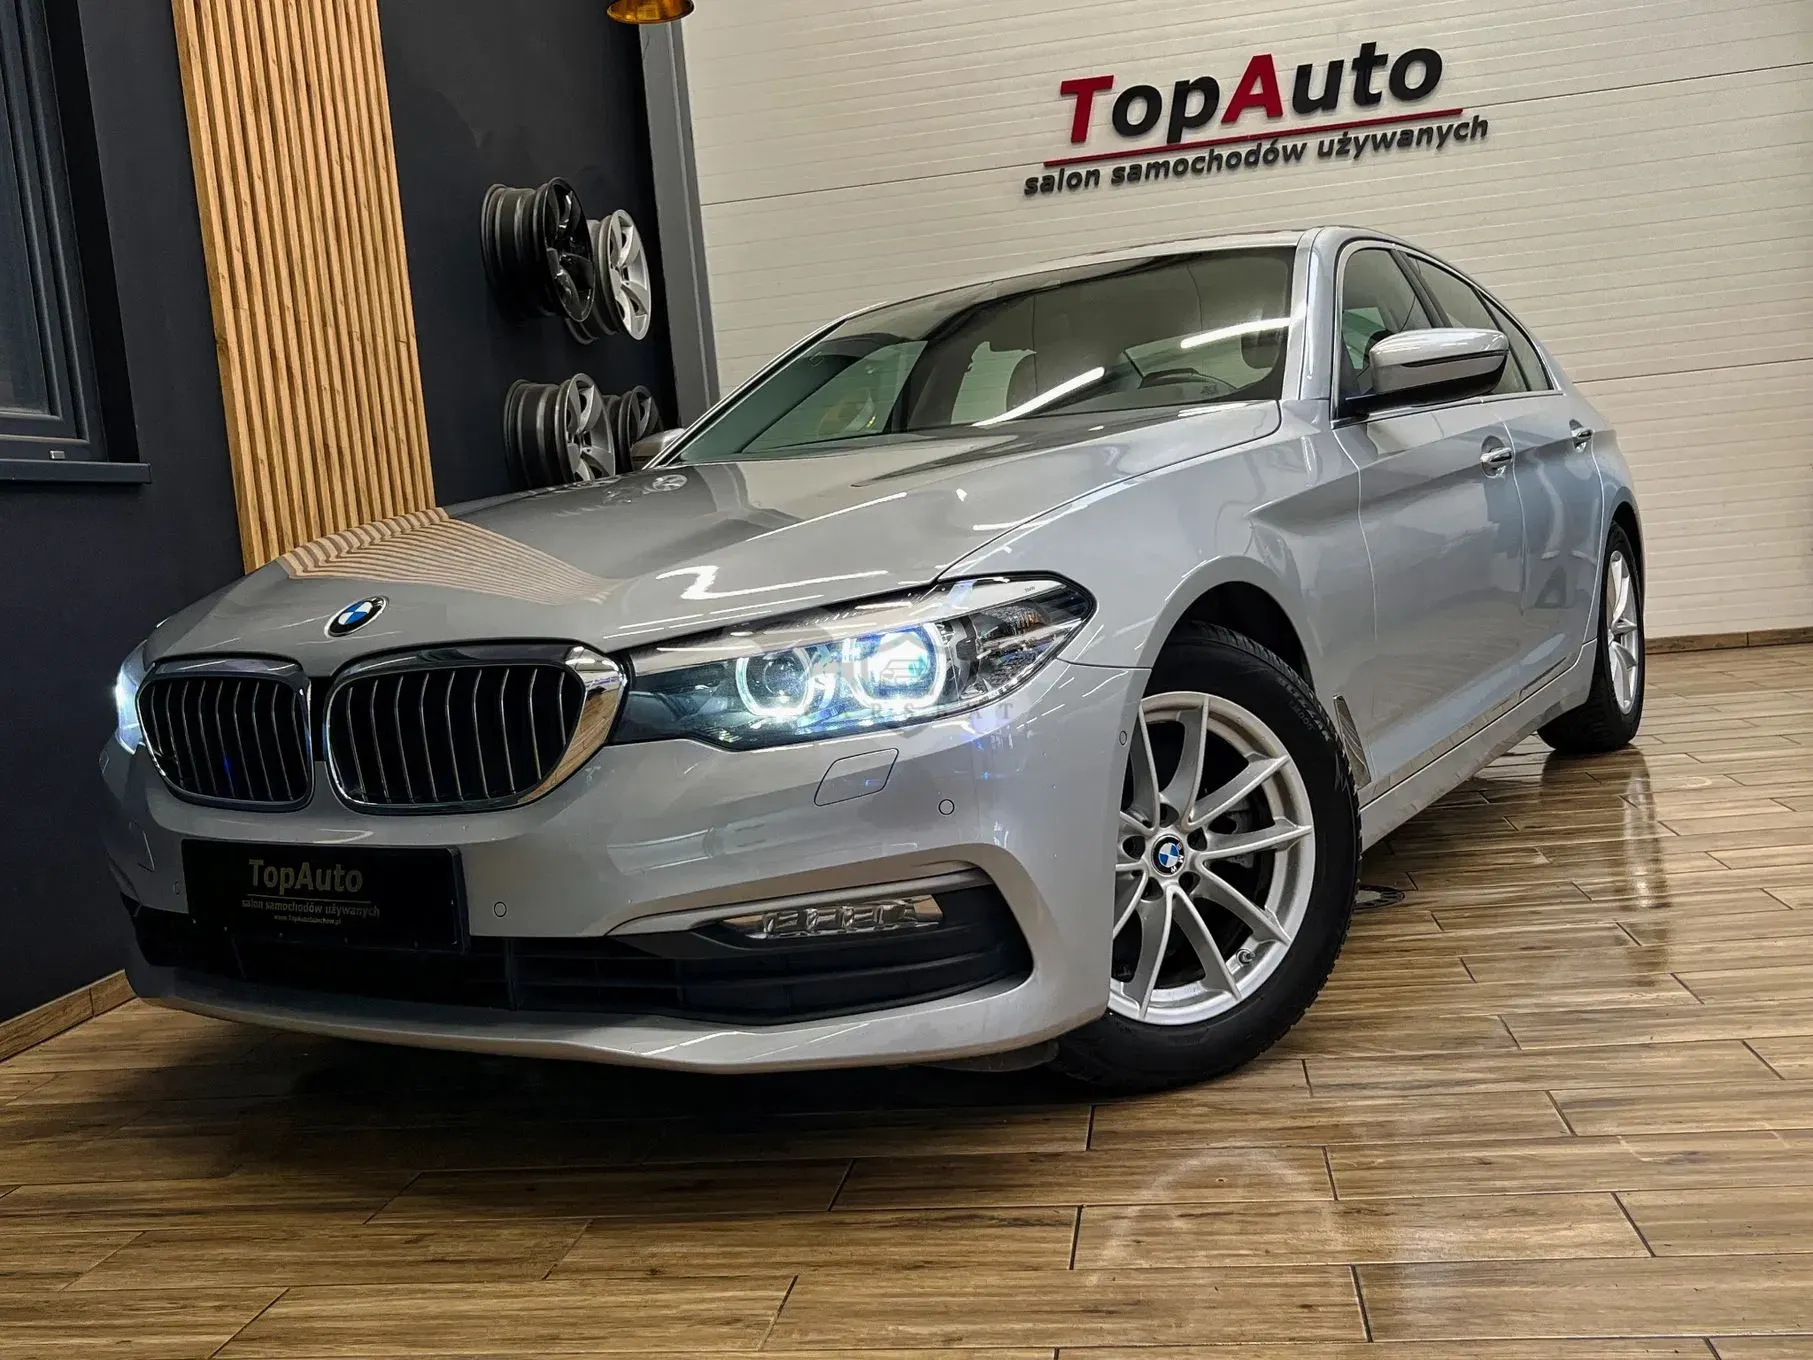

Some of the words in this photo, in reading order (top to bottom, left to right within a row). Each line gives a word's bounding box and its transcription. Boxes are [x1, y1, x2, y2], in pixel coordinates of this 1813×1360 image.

[1060, 41, 1444, 144] TopAuto
[1024, 165, 1100, 196] salon
[1110, 137, 1307, 186] samochodów
[1317, 114, 1488, 161] używanych
[249, 858, 364, 896] TopAuto
[241, 898, 264, 910] salon
[265, 899, 323, 914] samochodów
[325, 903, 380, 919] używanych
